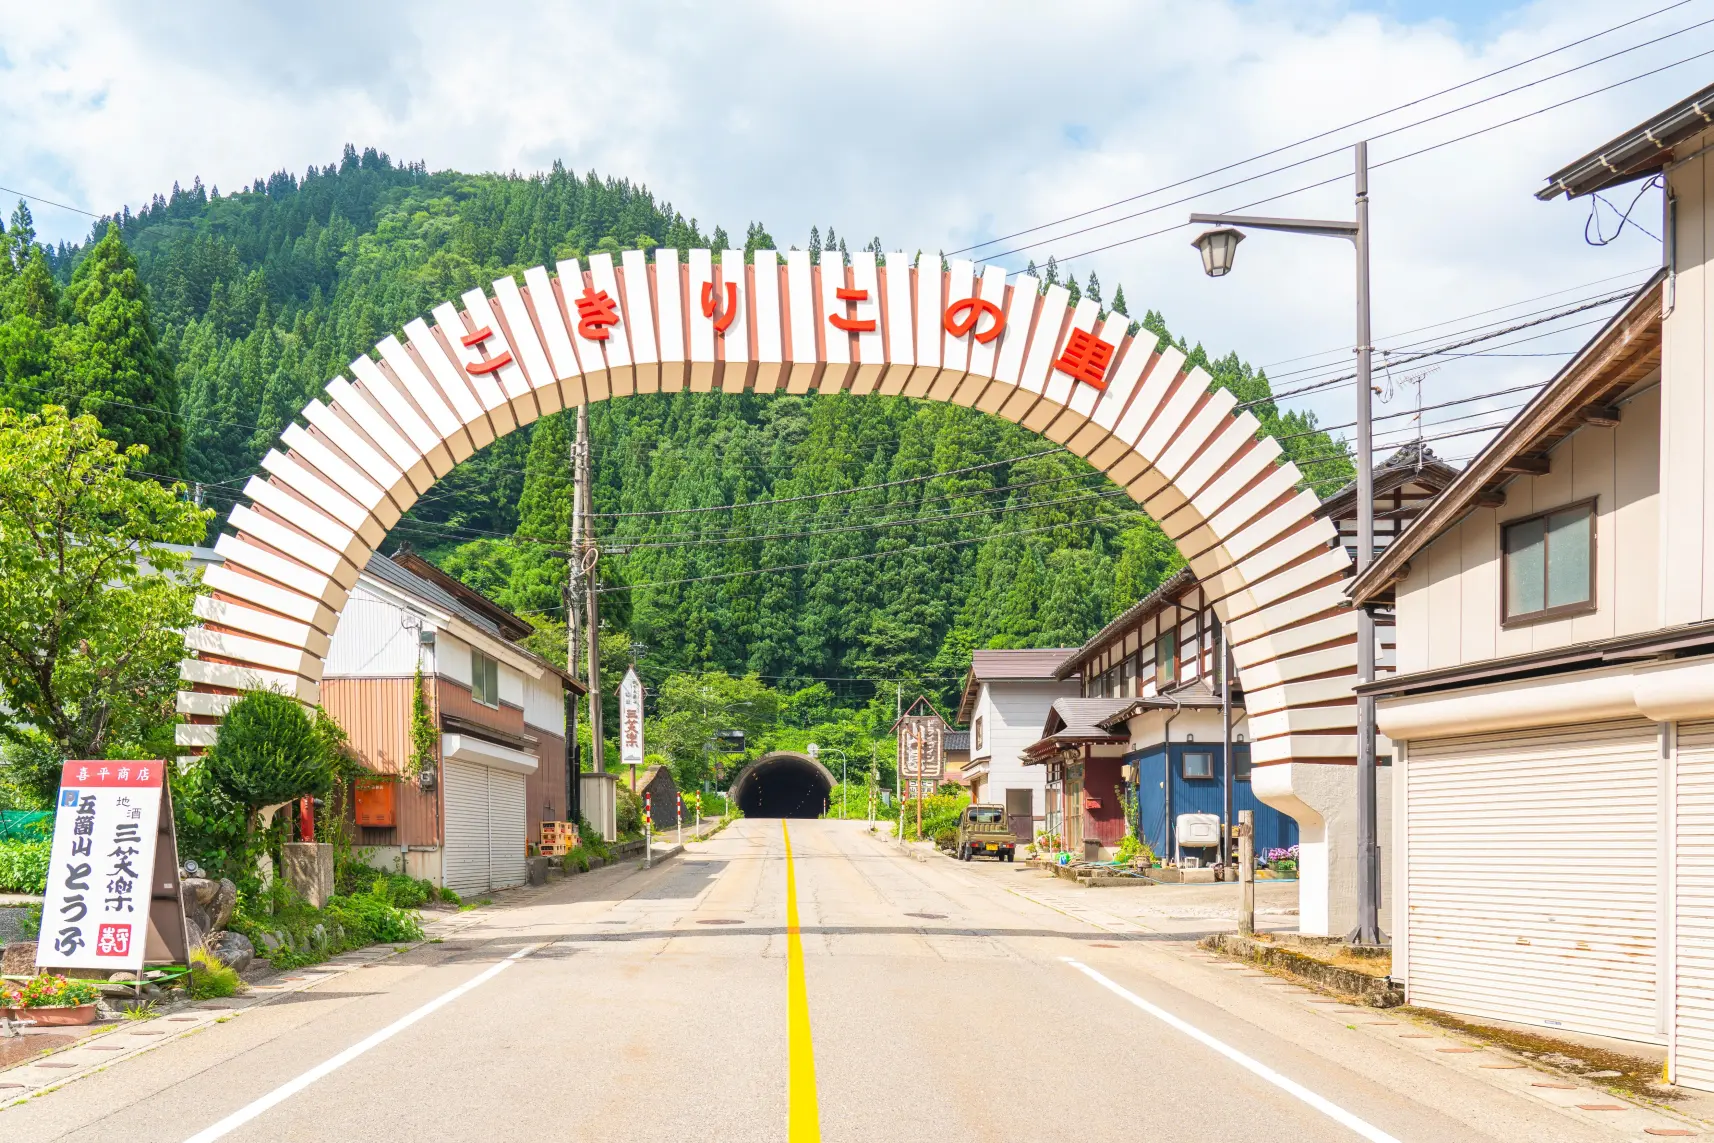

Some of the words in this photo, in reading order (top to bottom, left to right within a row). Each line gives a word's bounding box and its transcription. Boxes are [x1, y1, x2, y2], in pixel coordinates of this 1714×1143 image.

[460, 281, 1115, 390] こきりこの里
[76, 767, 150, 782] 喜平商店
[116, 796, 142, 819] 地酒
[54, 794, 97, 957] 五箇山とうふ
